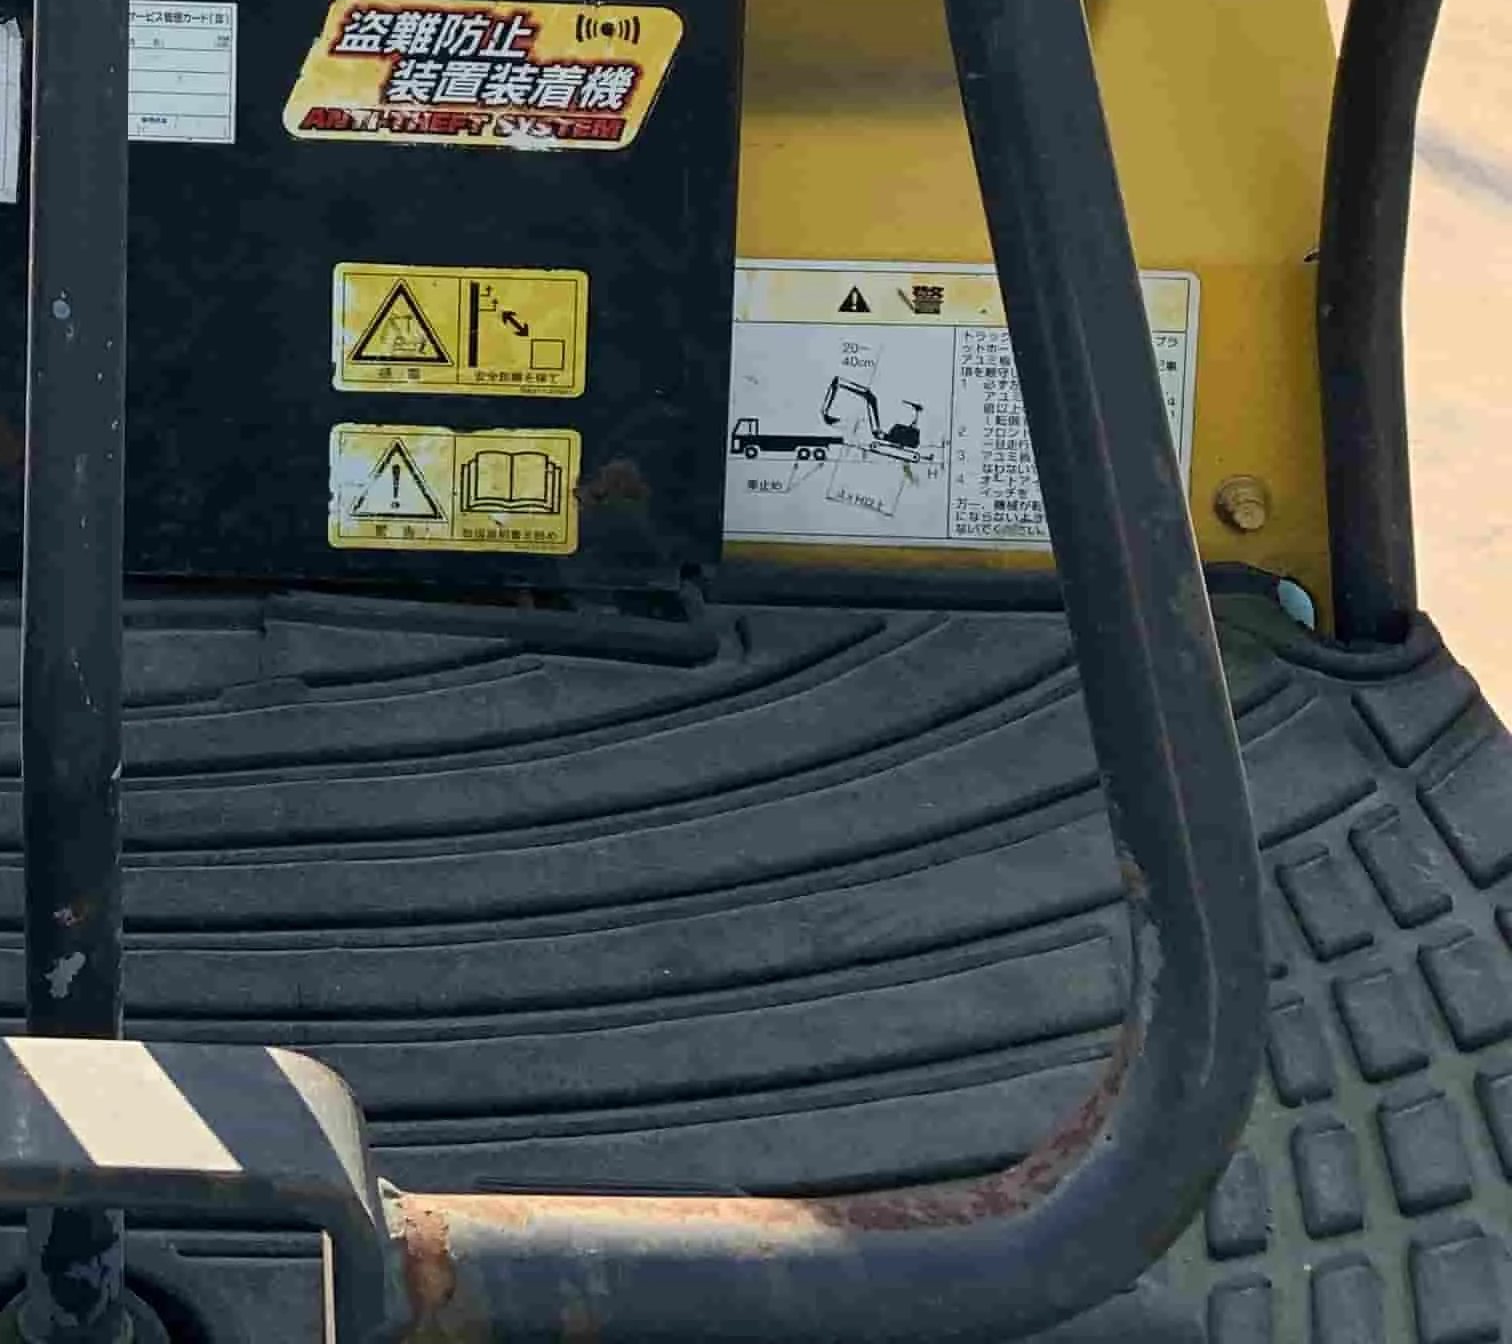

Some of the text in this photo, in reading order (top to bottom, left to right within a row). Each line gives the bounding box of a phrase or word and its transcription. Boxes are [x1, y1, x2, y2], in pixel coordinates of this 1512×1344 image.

[334, 9, 534, 59] 盗難防止
[387, 58, 636, 110] 装置装着機
[300, 107, 627, 141] ANTI-THEFT SYSTEM
